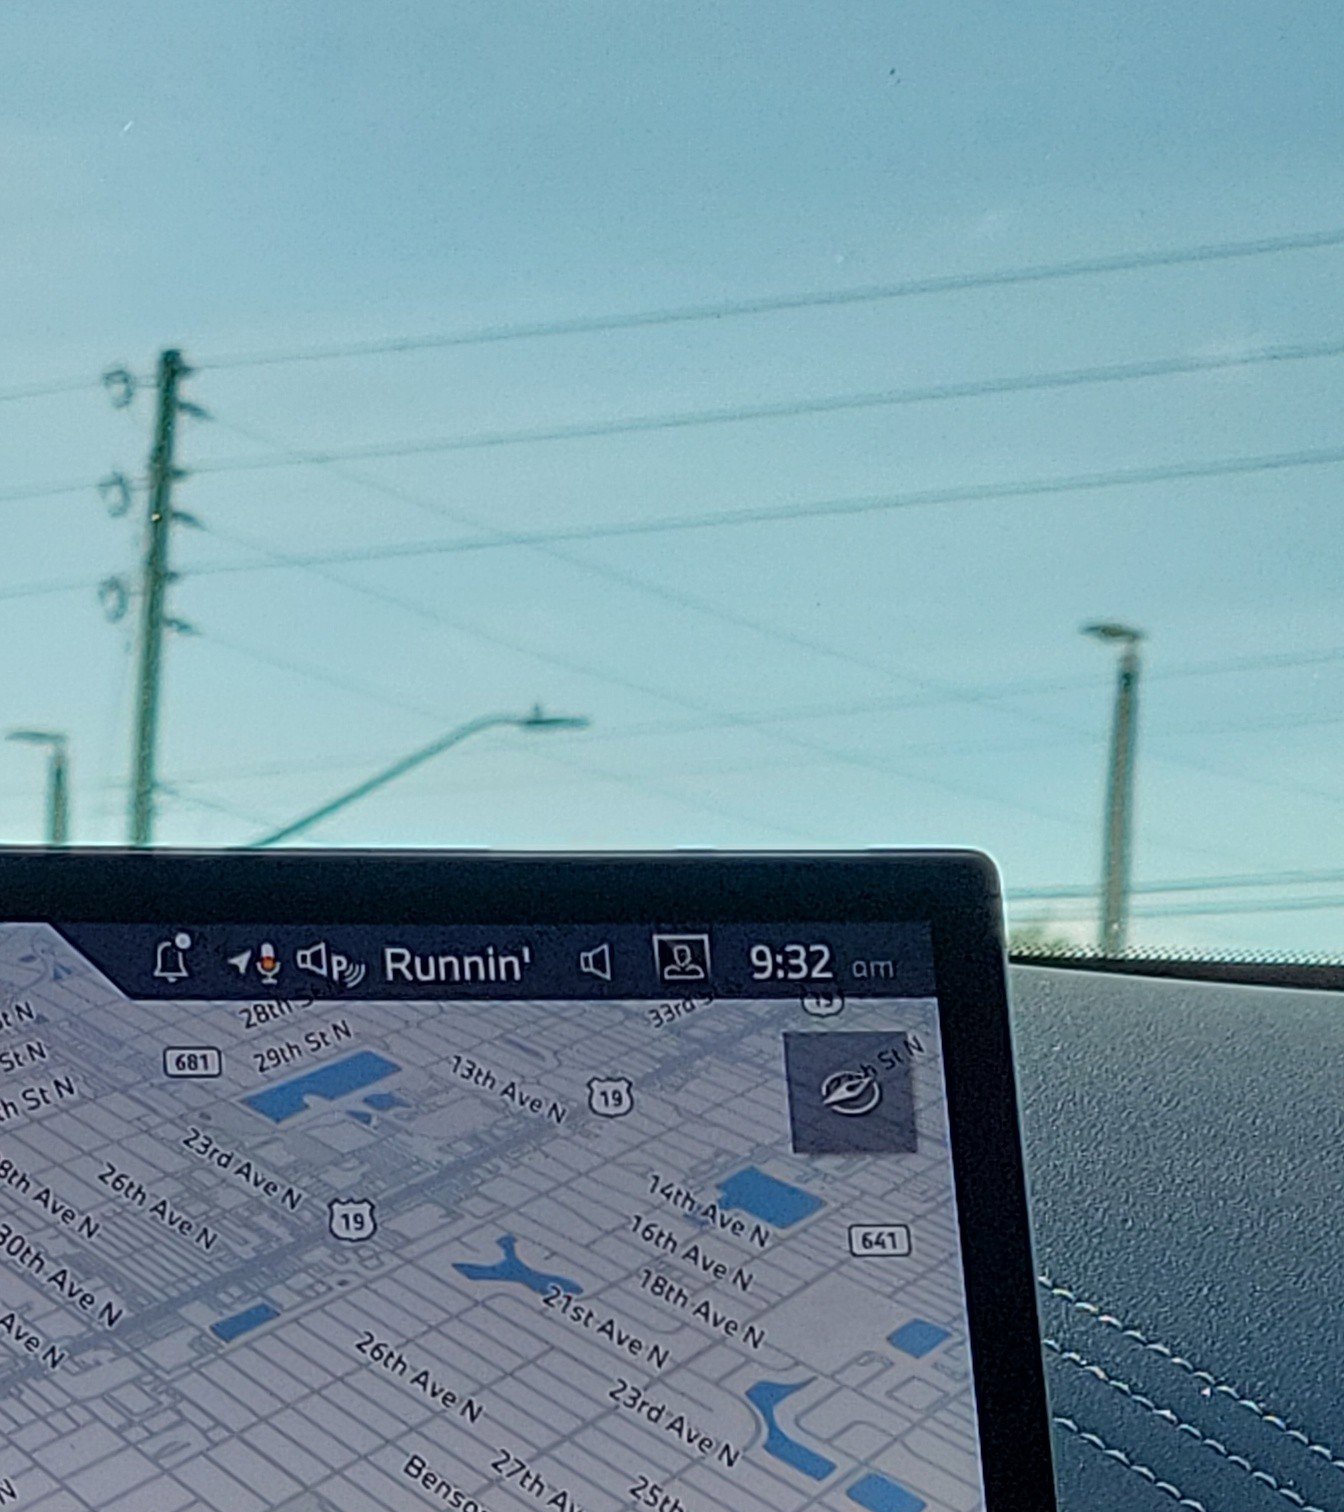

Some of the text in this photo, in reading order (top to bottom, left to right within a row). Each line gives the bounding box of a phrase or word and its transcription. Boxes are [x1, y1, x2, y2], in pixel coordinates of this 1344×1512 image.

[383, 944, 531, 983] Runnin'
[750, 944, 895, 981] 9:32 am
[27, 1041, 47, 1062] N
[174, 1053, 210, 1071] 681
[253, 1019, 353, 1074] 29th St N
[20, 1086, 51, 1110] St
[54, 1076, 76, 1098] N
[449, 1055, 567, 1124] 13th Ave N
[601, 1089, 623, 1108] 19
[181, 1128, 303, 1211] 23rd Ave N
[32, 1186, 78, 1225] Ave
[79, 1215, 101, 1240] N
[341, 1212, 366, 1232] 19
[647, 1174, 771, 1248] 14th Ave N
[861, 1232, 899, 1250] 641
[542, 1285, 671, 1369] 21st Ave N
[639, 1269, 766, 1350] 18th Ave N
[42, 1345, 67, 1370] N
[354, 1330, 485, 1424] 26th Ave N
[490, 1447, 547, 1493] 27th
